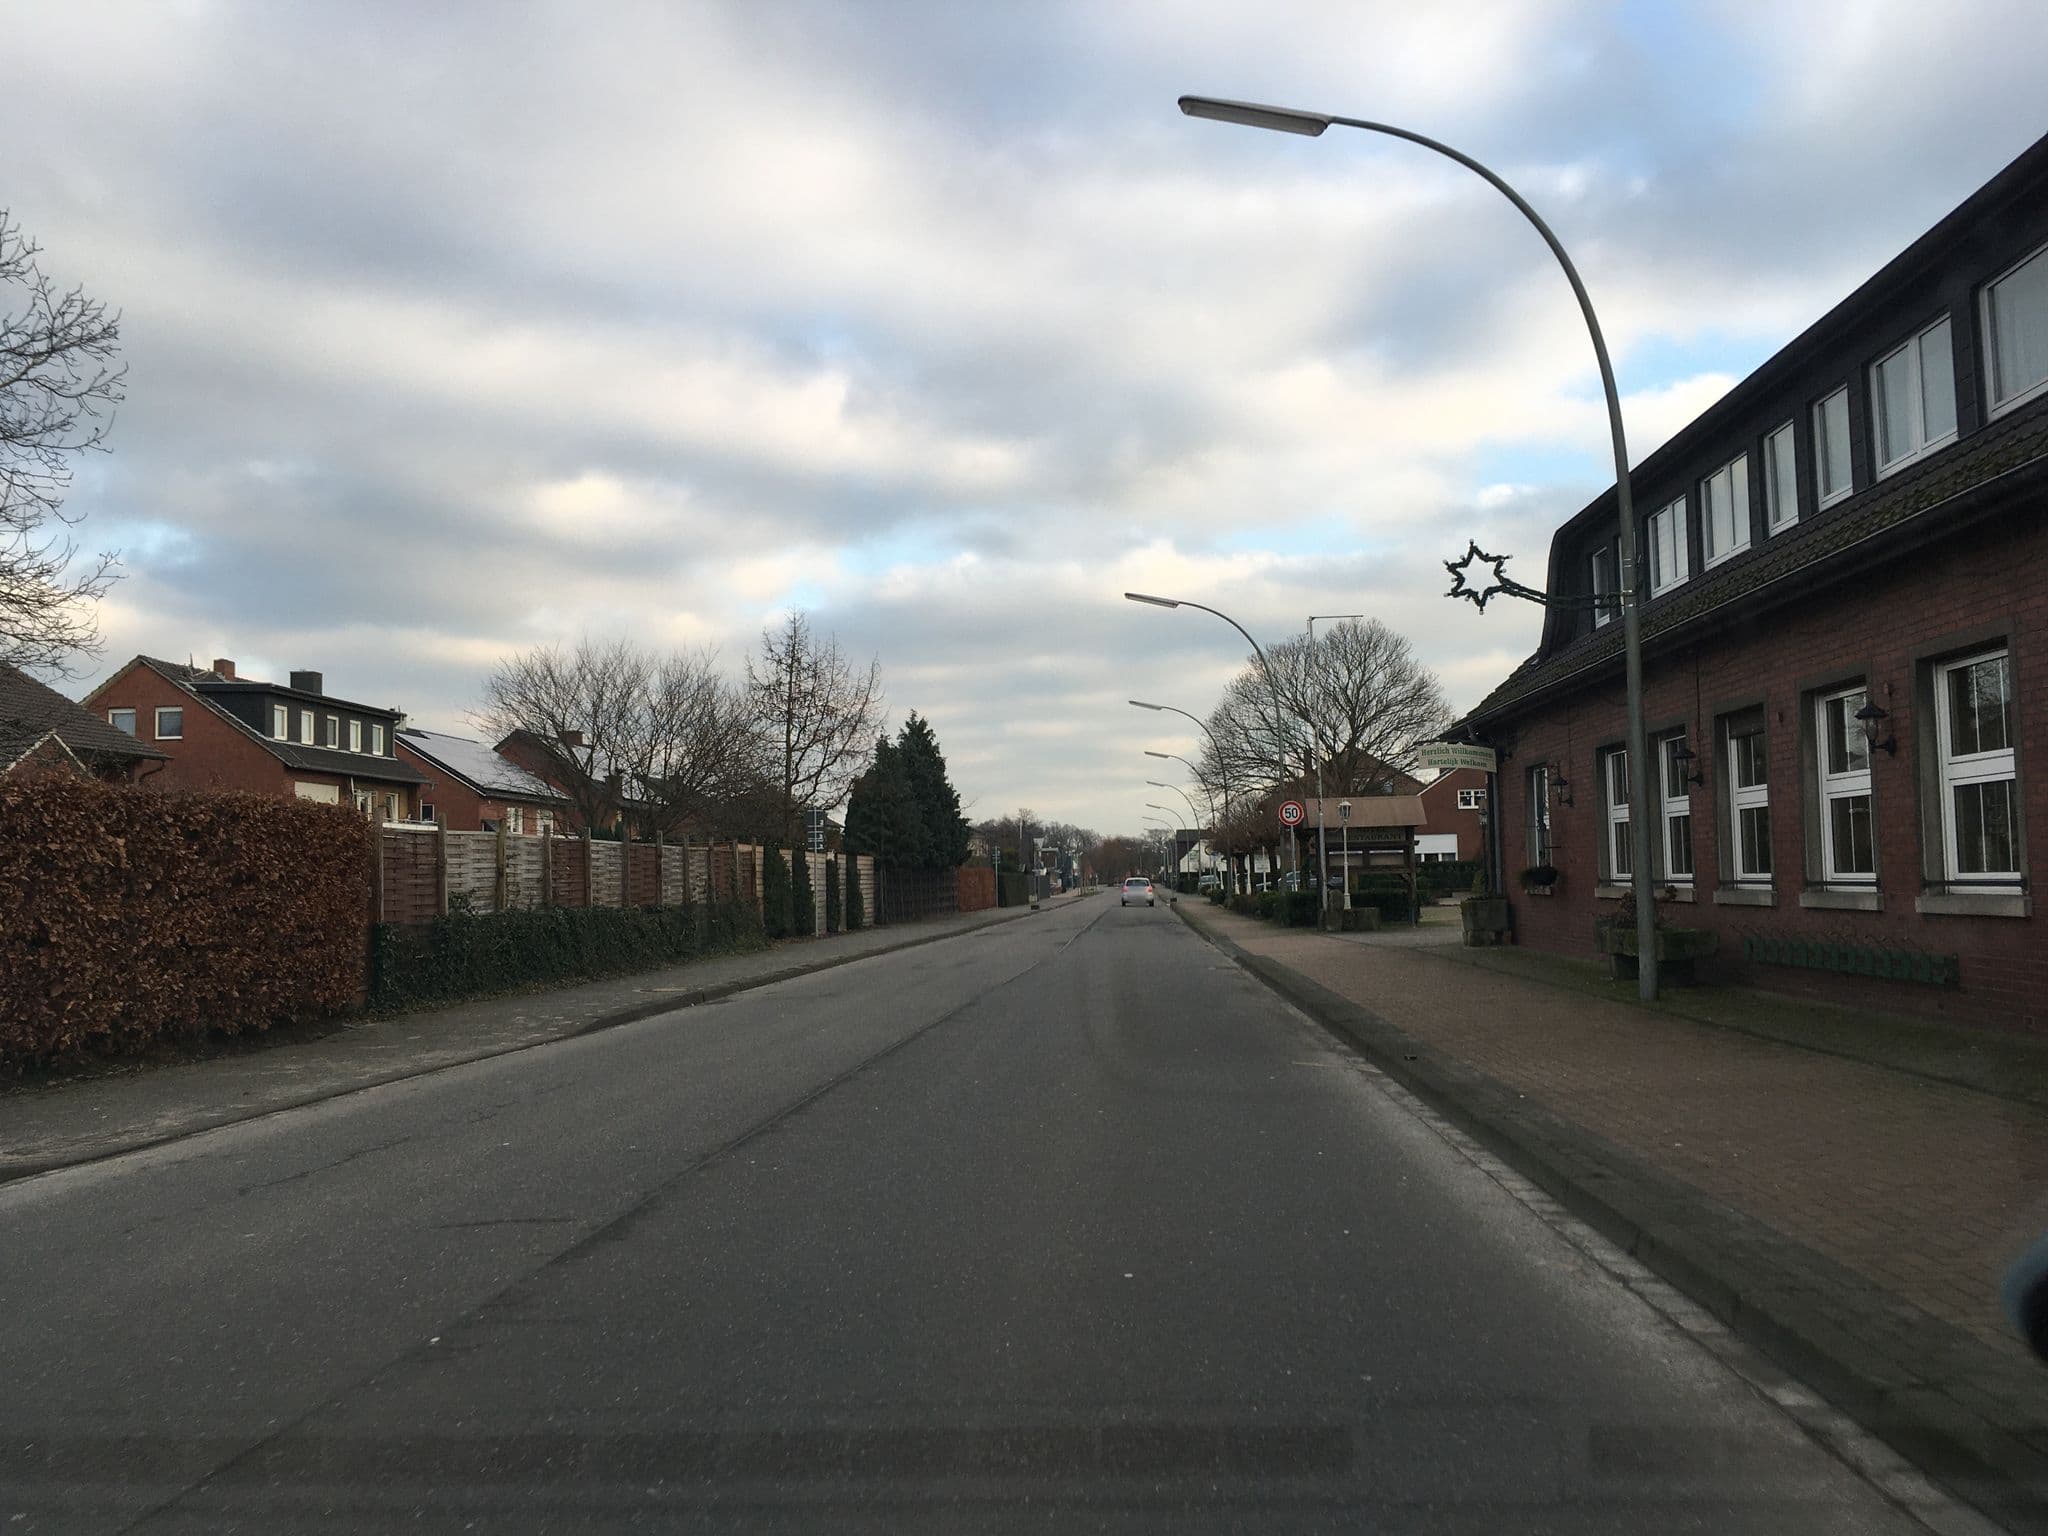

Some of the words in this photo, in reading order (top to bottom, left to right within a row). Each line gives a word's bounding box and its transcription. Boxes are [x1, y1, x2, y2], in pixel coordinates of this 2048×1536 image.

[1422, 747, 1450, 757] Herzlich
[1460, 758, 1487, 768] Welkom
[1285, 807, 1298, 819] 50
